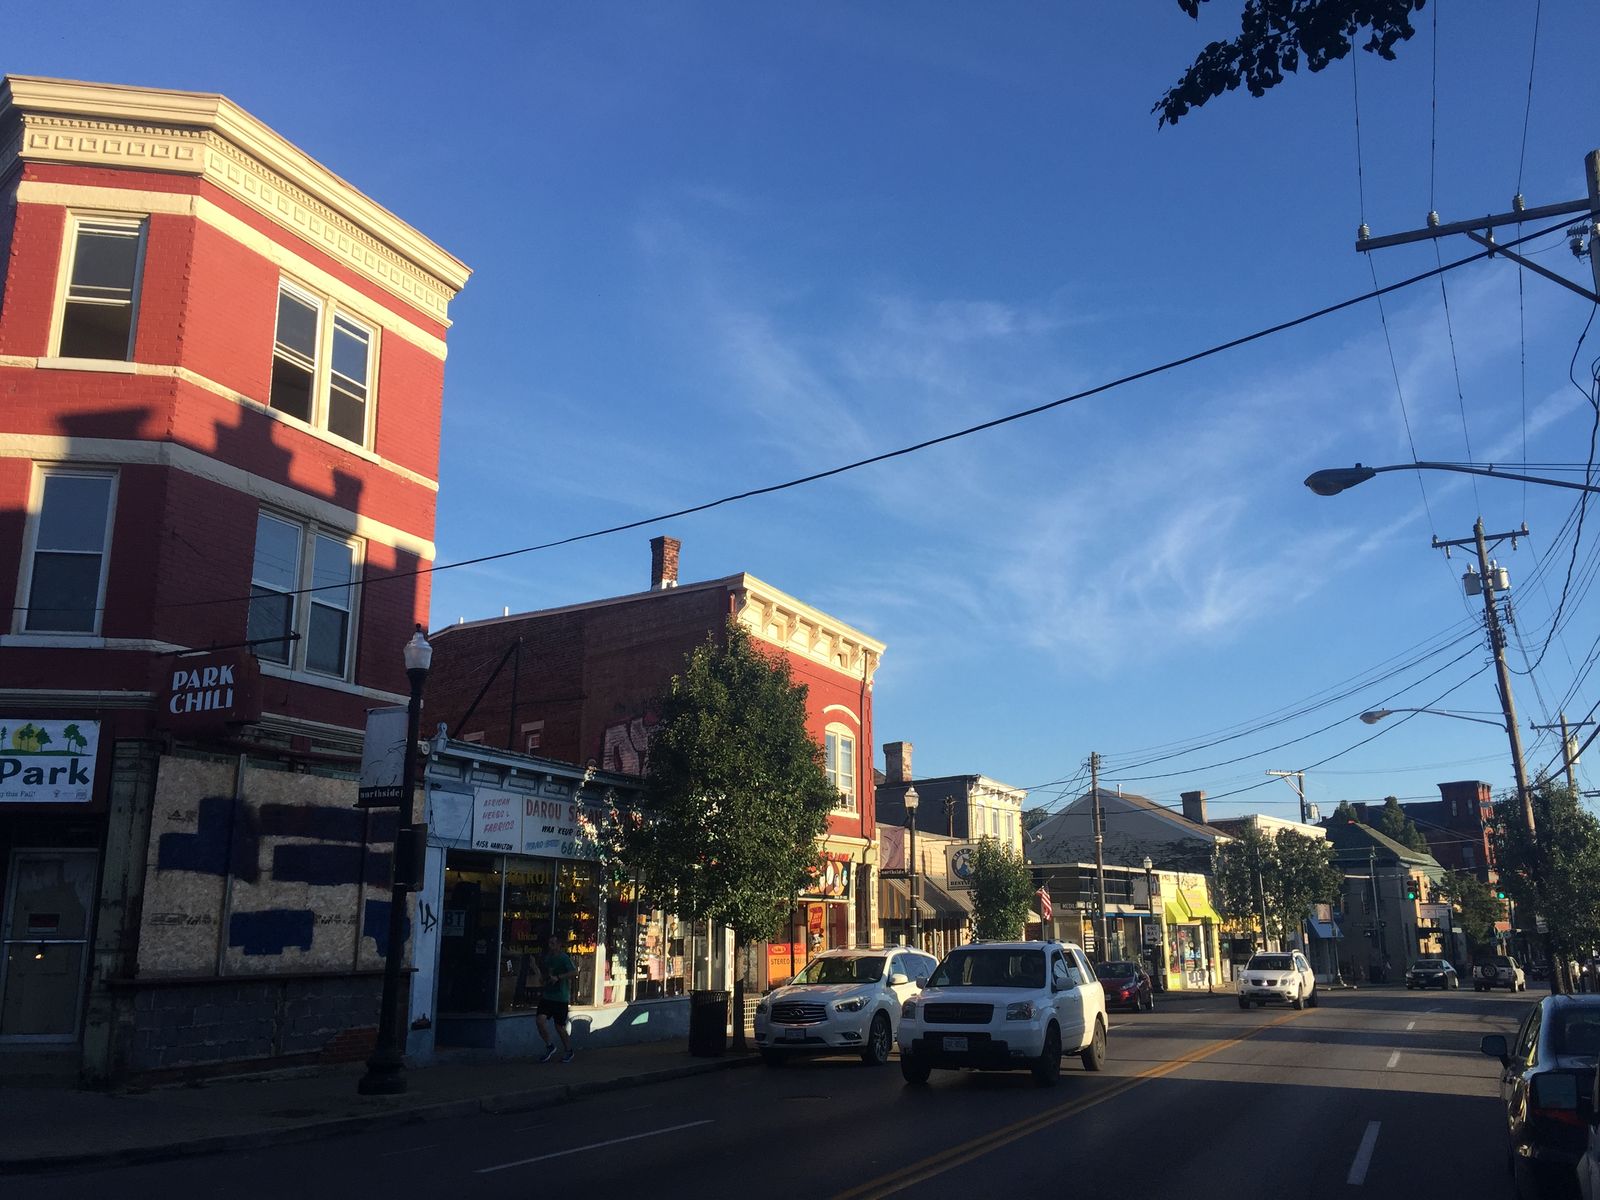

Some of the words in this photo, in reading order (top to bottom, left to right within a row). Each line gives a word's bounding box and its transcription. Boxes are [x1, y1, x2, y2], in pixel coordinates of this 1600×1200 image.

[172, 664, 234, 690] PARK
[169, 687, 234, 714] CHILI
[0, 758, 90, 785] Park
[526, 799, 562, 819] DAROU
[483, 820, 515, 833] FABRICS
[490, 842, 513, 851] HAMILTON
